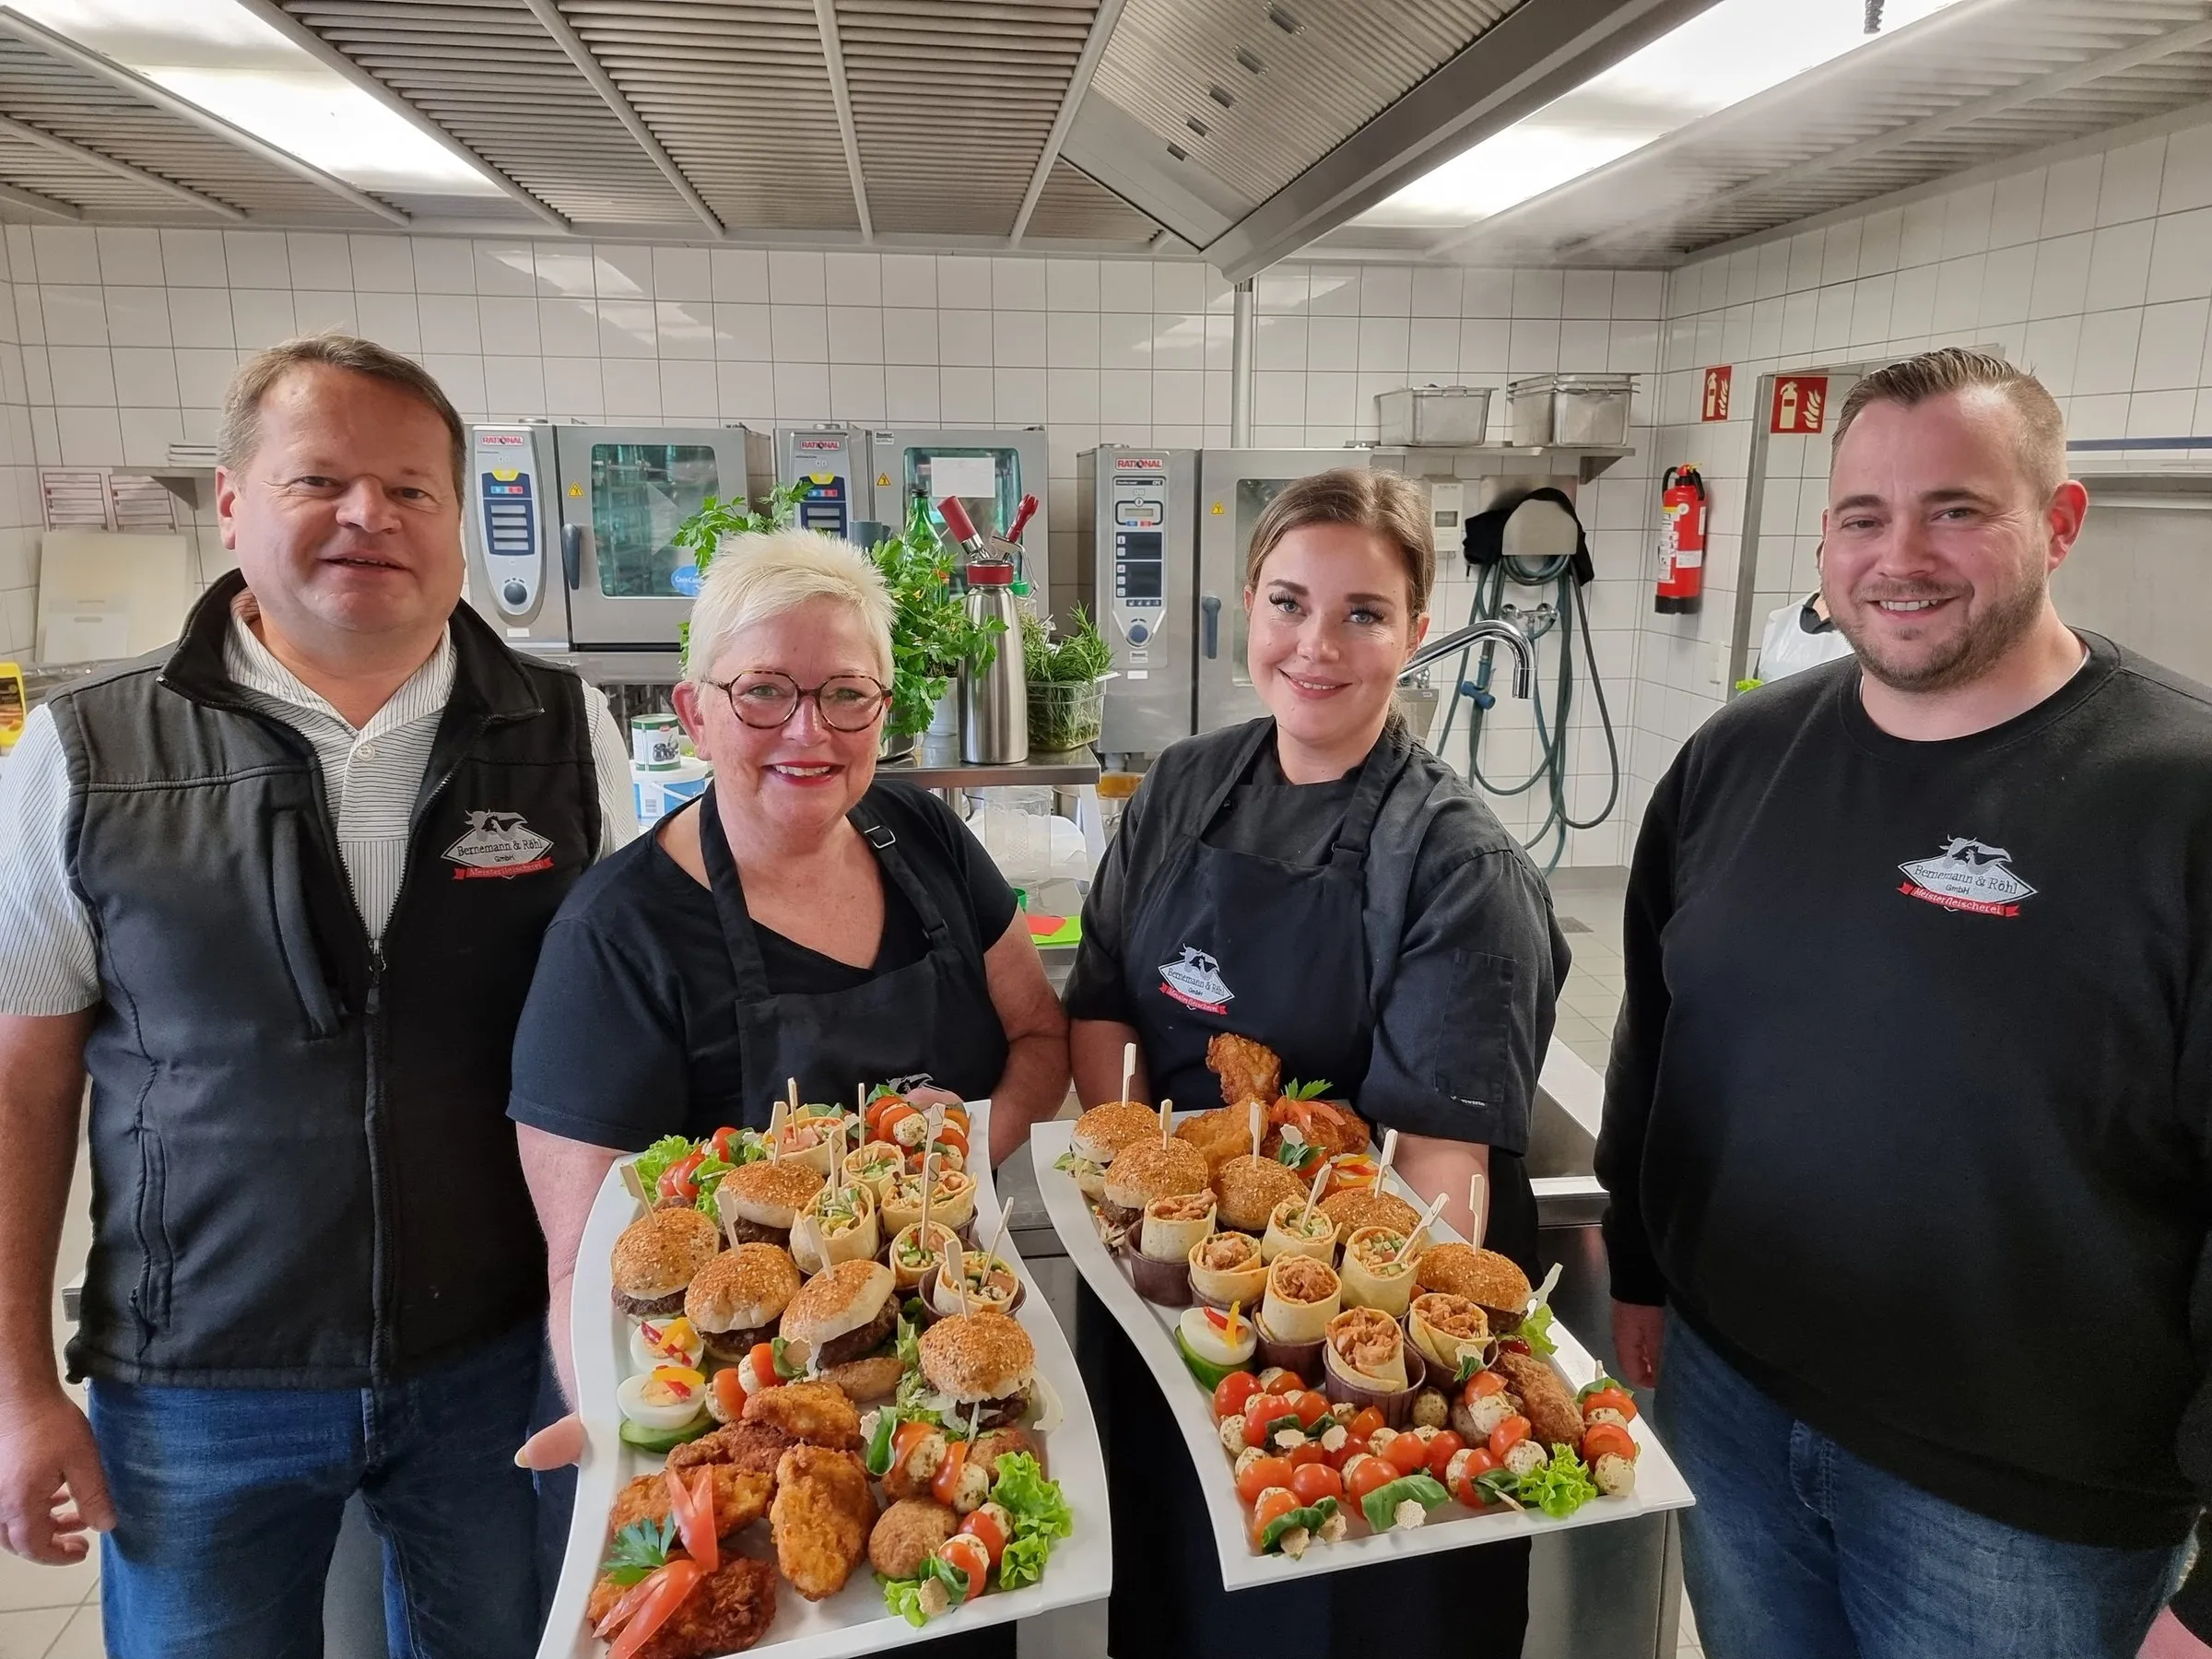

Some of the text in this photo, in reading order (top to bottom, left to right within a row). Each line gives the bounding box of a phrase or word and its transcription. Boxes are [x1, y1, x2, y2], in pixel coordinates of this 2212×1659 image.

[1118, 460, 1161, 468] RATIONAL
[457, 839, 542, 856] Bernemann & Röhl
[1914, 865, 2018, 894] Bernemann & Röhl
[1946, 884, 1970, 894] GmbH
[1913, 888, 2002, 914] Meisterfleischerei
[1168, 968, 1205, 987] Bernemann
[1206, 982, 1211, 990] &
